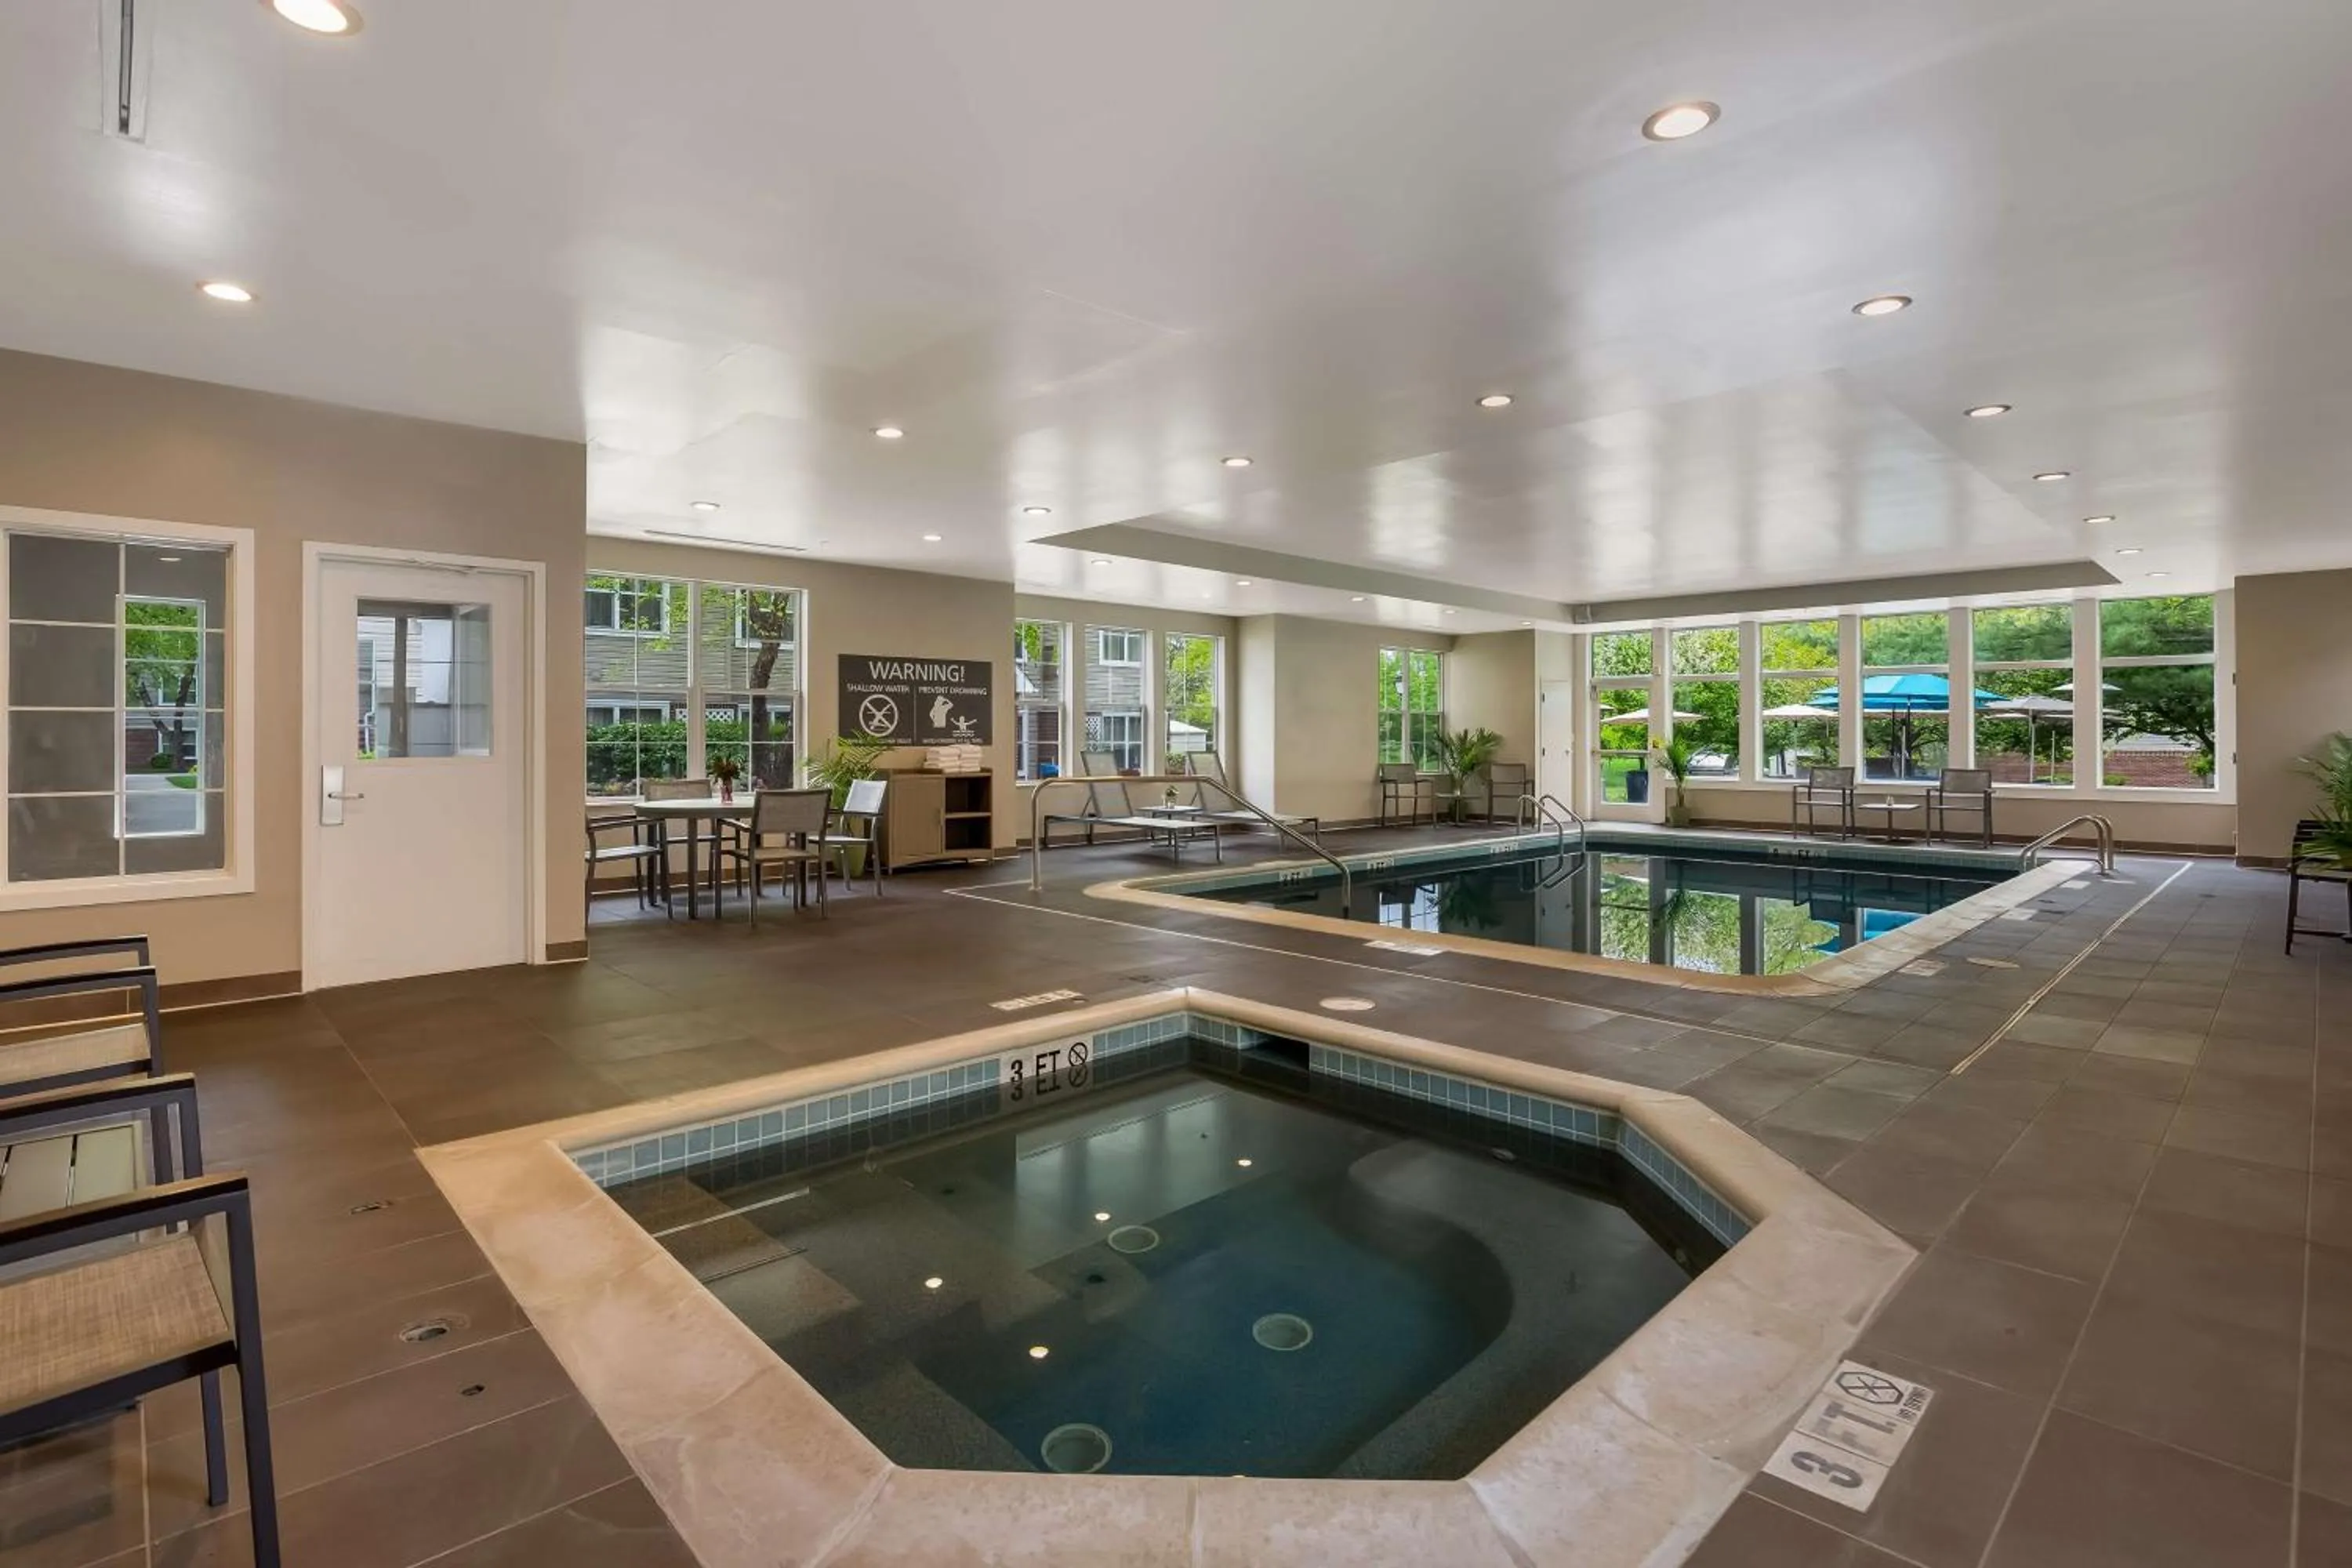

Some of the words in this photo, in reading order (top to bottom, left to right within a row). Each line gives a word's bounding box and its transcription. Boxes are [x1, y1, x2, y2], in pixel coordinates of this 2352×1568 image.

[869, 661, 965, 682] WARNING!
[847, 684, 884, 692] SHALLOW
[1011, 1060, 1023, 1083] 3
[1036, 1050, 1061, 1077] FT
[1791, 1451, 1863, 1489] 3
